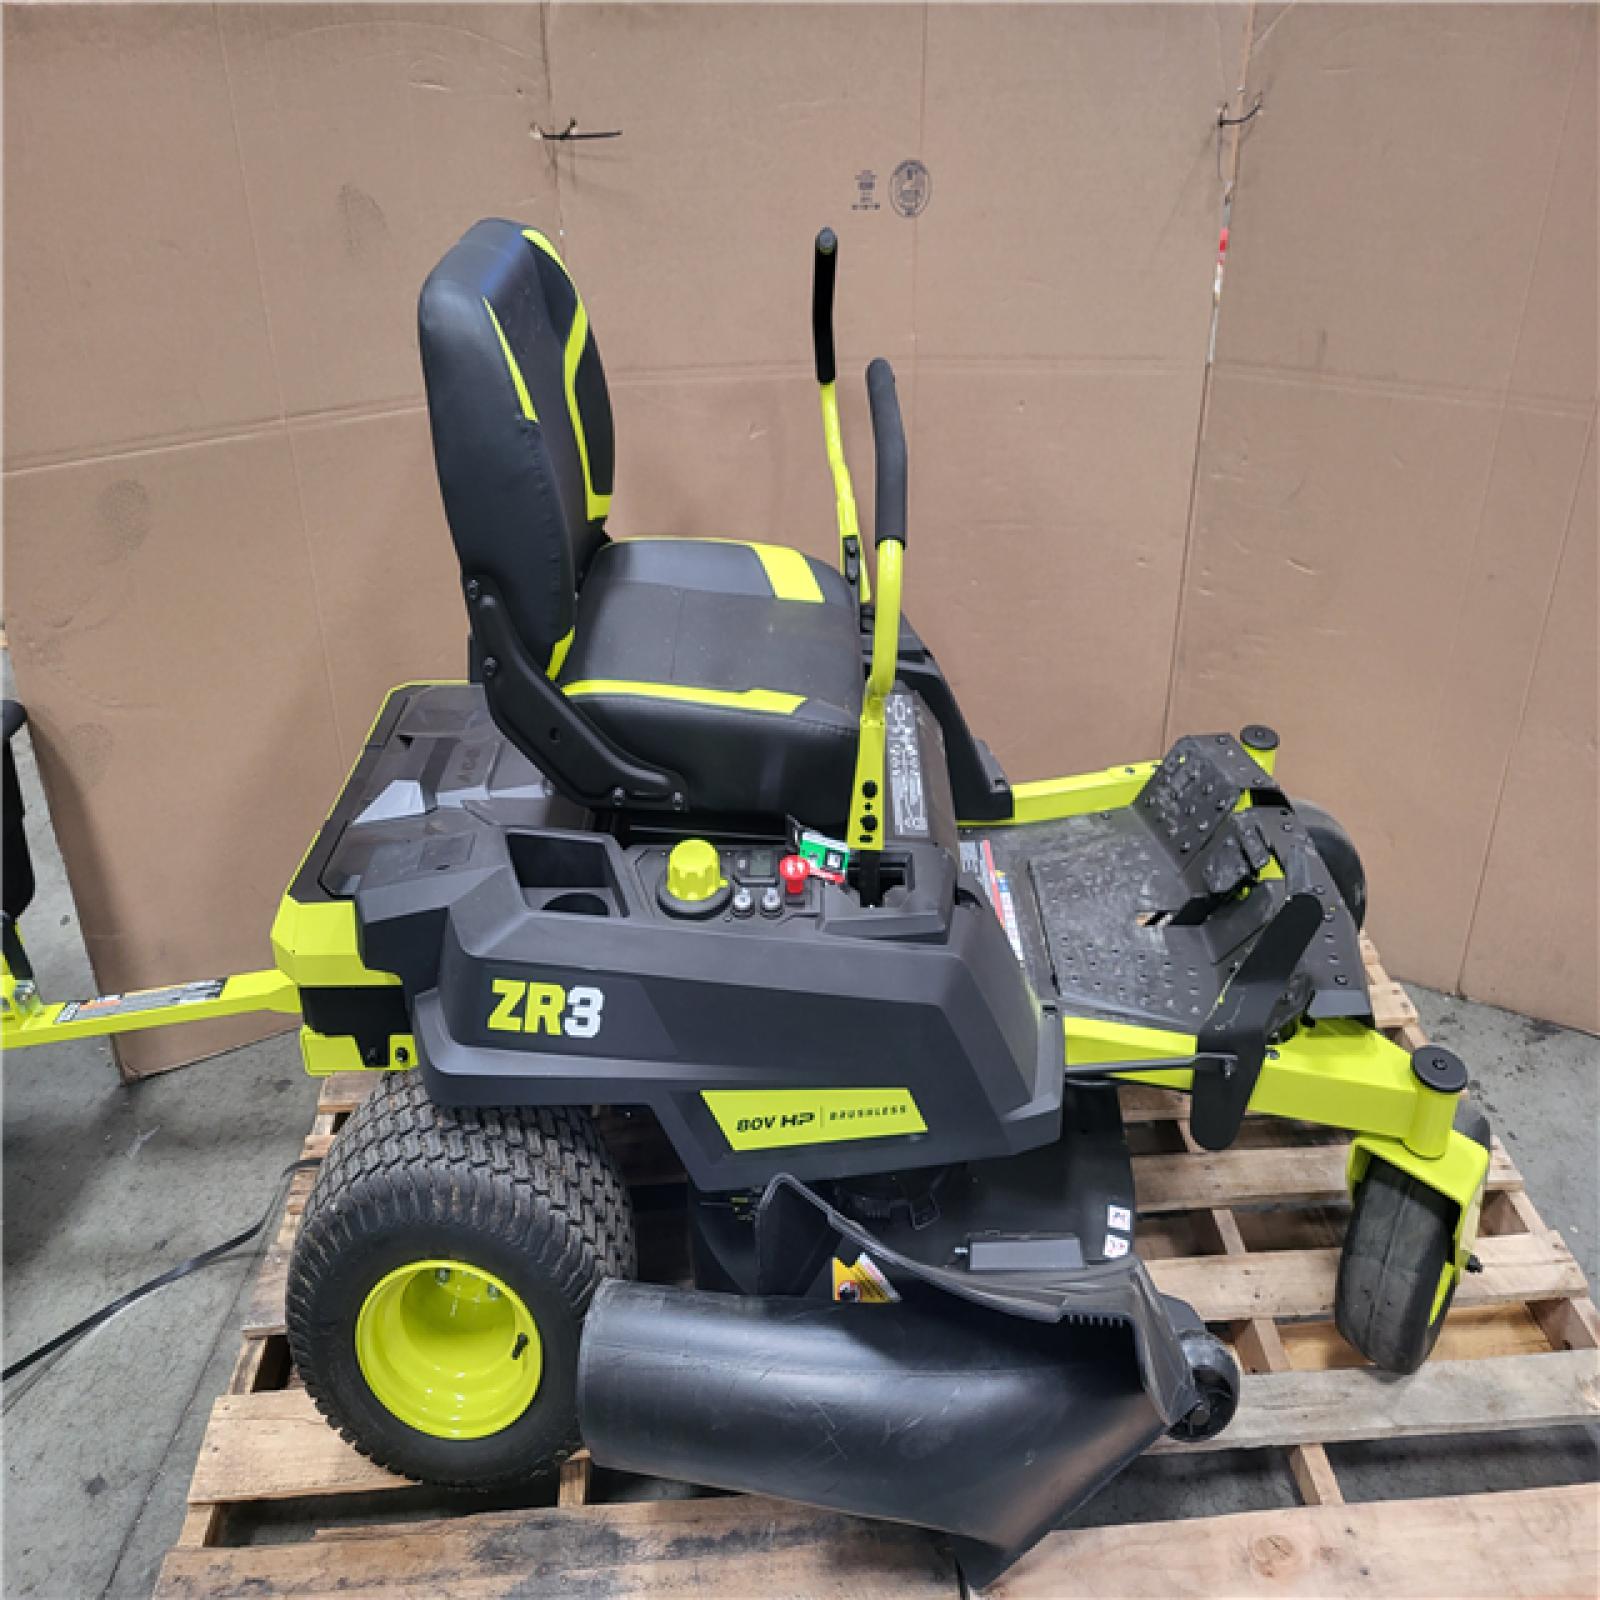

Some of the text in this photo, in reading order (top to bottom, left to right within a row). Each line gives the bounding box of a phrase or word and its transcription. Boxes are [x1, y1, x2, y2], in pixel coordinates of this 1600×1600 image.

[488, 979, 604, 1038] ZR3
[737, 1116, 776, 1132] 80V
[780, 1112, 815, 1128] HP
